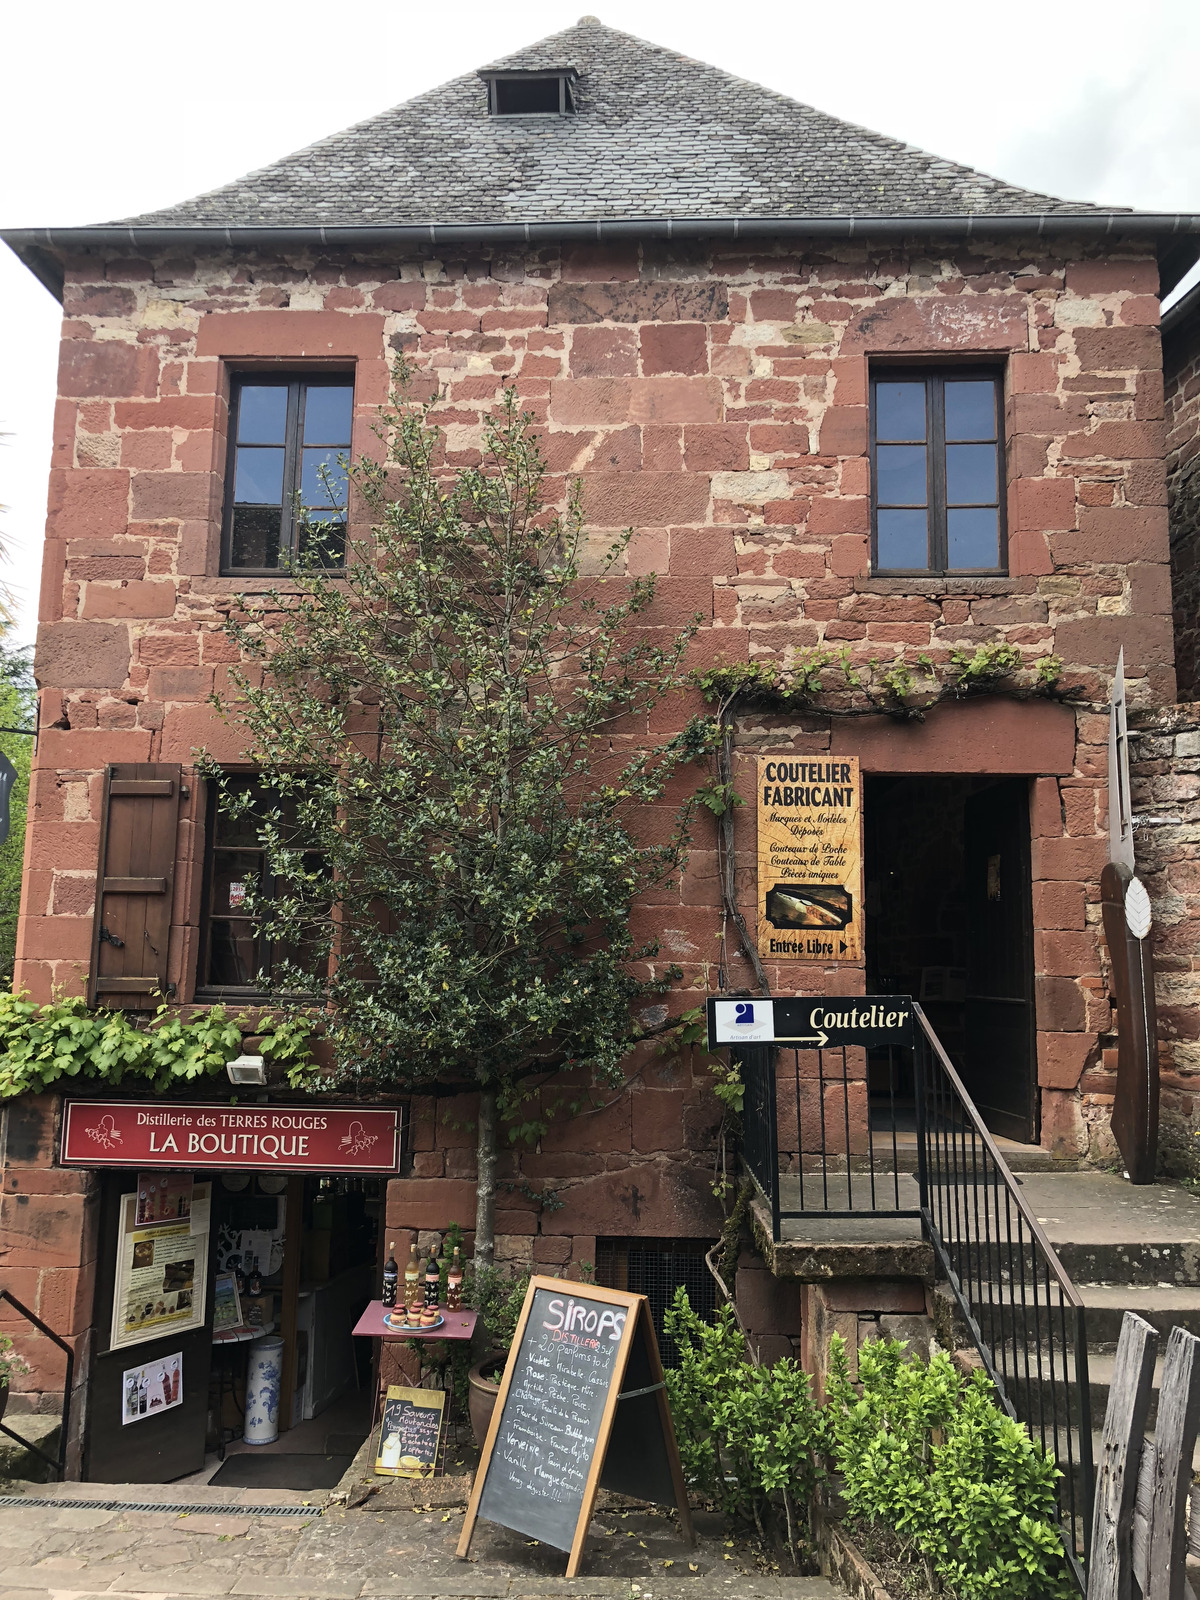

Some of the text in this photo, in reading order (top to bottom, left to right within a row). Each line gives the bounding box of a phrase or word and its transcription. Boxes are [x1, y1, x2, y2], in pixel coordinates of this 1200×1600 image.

[766, 762, 851, 783] COUTELIER
[764, 787, 854, 807] FABRICANT
[765, 812, 847, 825] Marques et Modèles
[790, 825, 823, 838] Déposés
[769, 842, 848, 854] Couteaux de Poche
[770, 855, 846, 866] Couteaux de Table
[780, 867, 839, 882] Pièces uniques
[770, 938, 833, 954] Entrée Libre
[810, 1005, 908, 1029] Coutelier
[137, 1113, 327, 1130] Distillerie des TERRES ROUGES
[149, 1132, 310, 1159] LA BOUTIQUE
[538, 1334, 555, 1353] 20
[557, 1344, 591, 1364] parfums
[526, 1366, 545, 1380] Rose
[550, 1374, 577, 1393] Pastèque
[529, 1353, 609, 1388] Violette Mirabelle Cassis
[572, 1394, 587, 1410] Poire
[402, 1406, 436, 1420] Saveurs
[513, 1419, 544, 1442] Framboise
[504, 1450, 528, 1472] Vanille
[534, 1464, 560, 1487] Mangue
